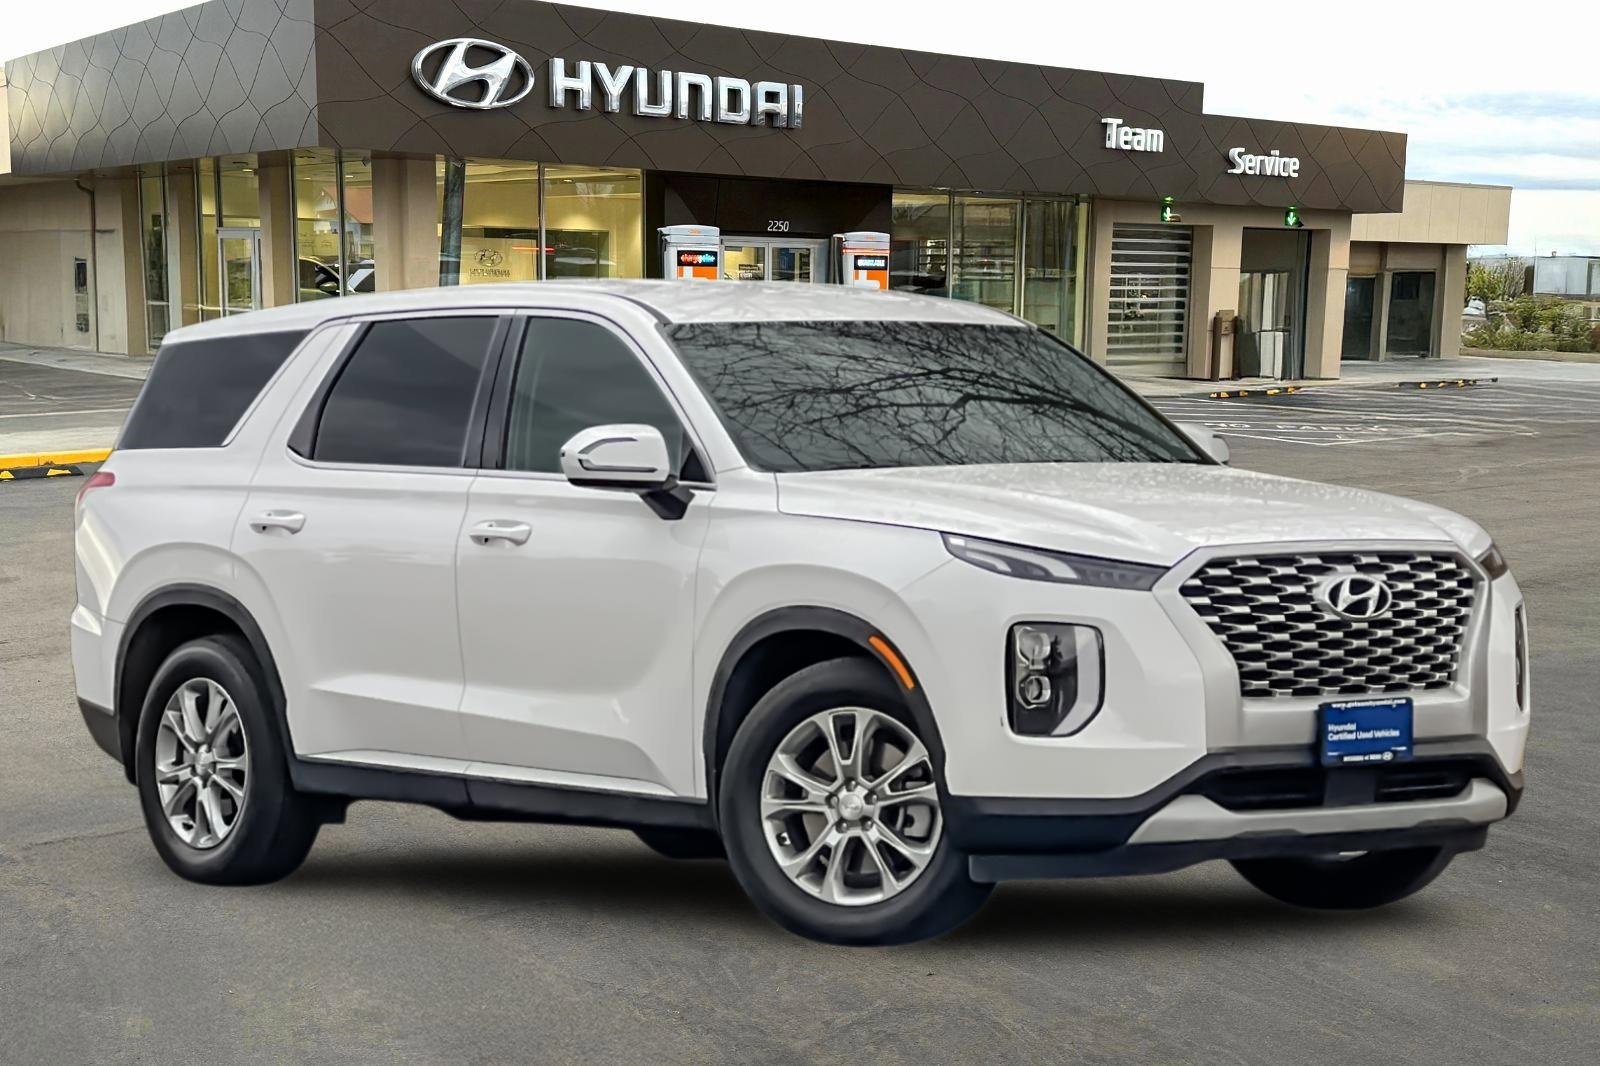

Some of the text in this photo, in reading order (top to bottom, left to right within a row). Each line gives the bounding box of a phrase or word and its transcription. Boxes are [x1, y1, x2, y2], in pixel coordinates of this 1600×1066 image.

[549, 57, 803, 129] HYUNDAI
[1101, 118, 1164, 153] Team
[1227, 147, 1300, 178] Service
[767, 220, 790, 232] 2250
[1356, 730, 1374, 740] Used
